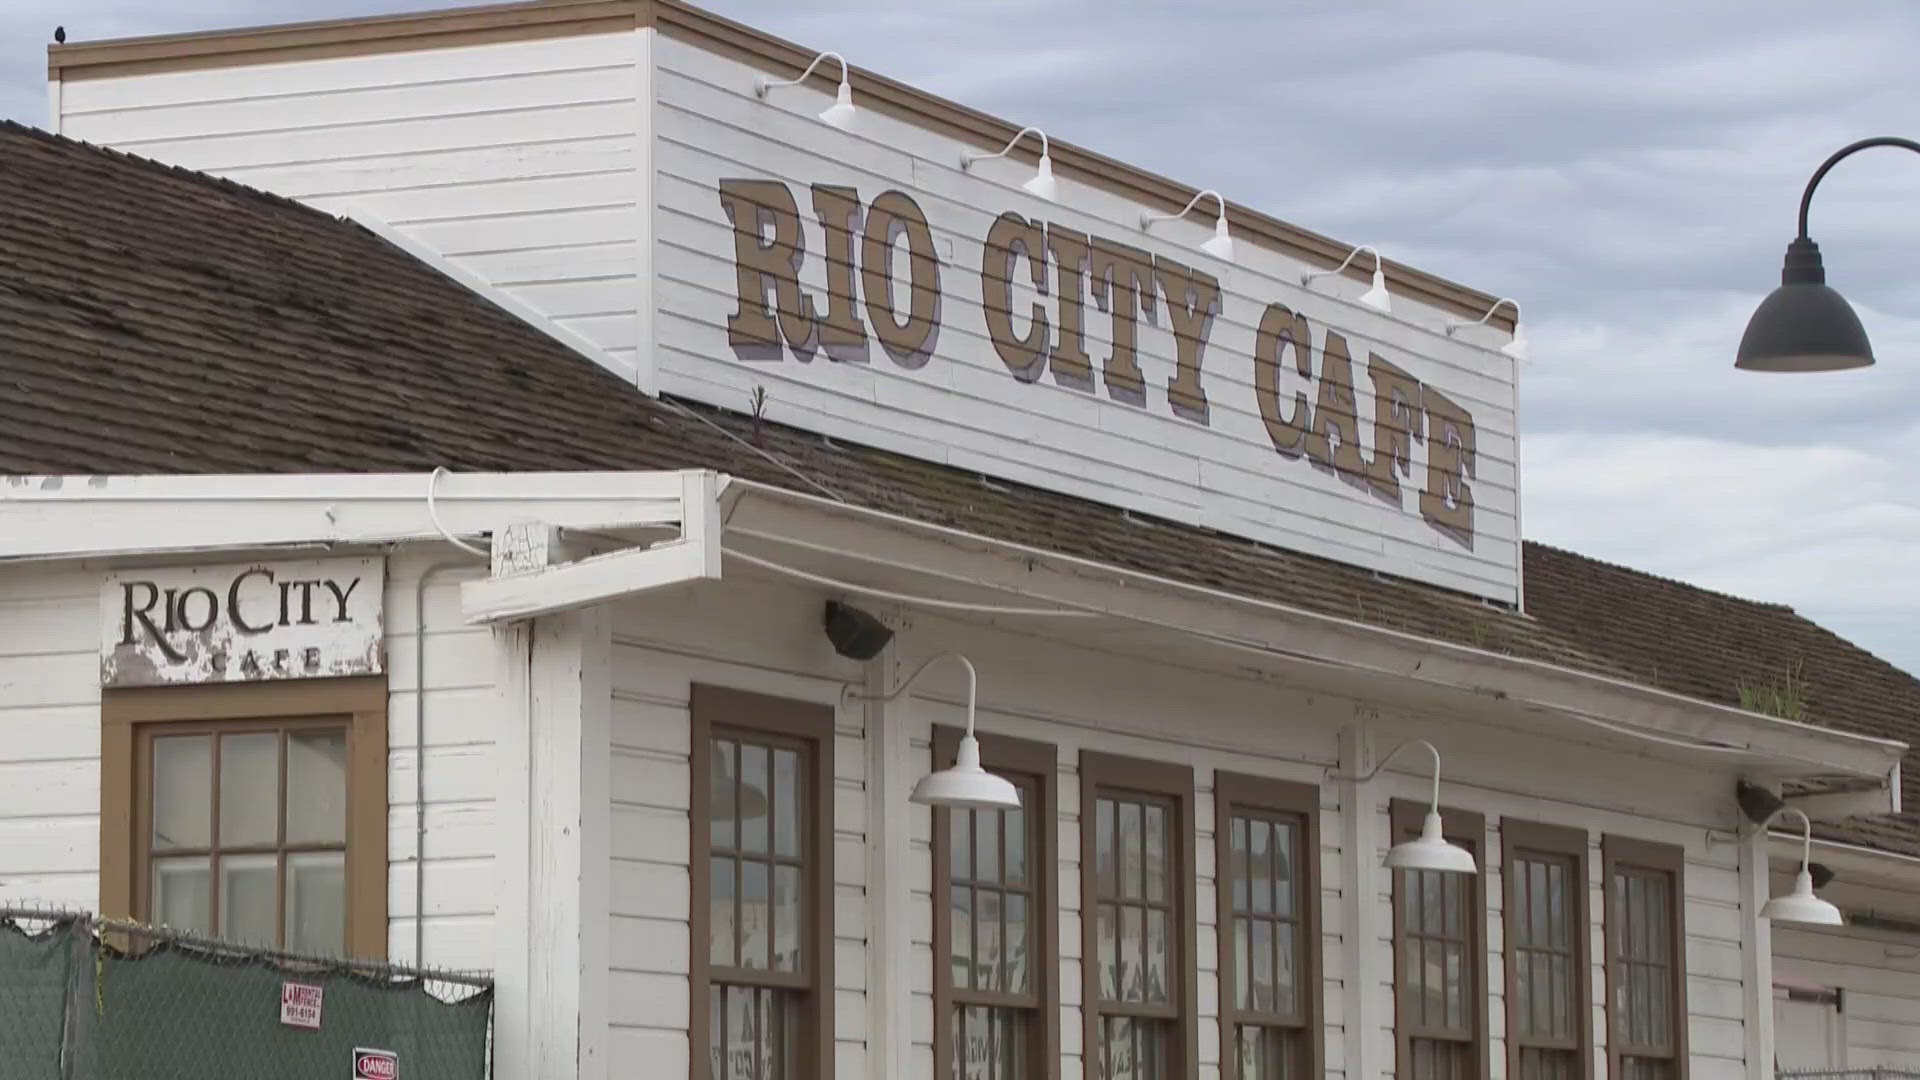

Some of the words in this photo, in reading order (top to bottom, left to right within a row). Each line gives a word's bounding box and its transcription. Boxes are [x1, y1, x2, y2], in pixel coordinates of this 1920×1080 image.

[719, 178, 942, 369] RIO
[982, 210, 1222, 426] CITY
[1254, 302, 1476, 552] CAFE
[363, 1057, 394, 1074] DANGER
